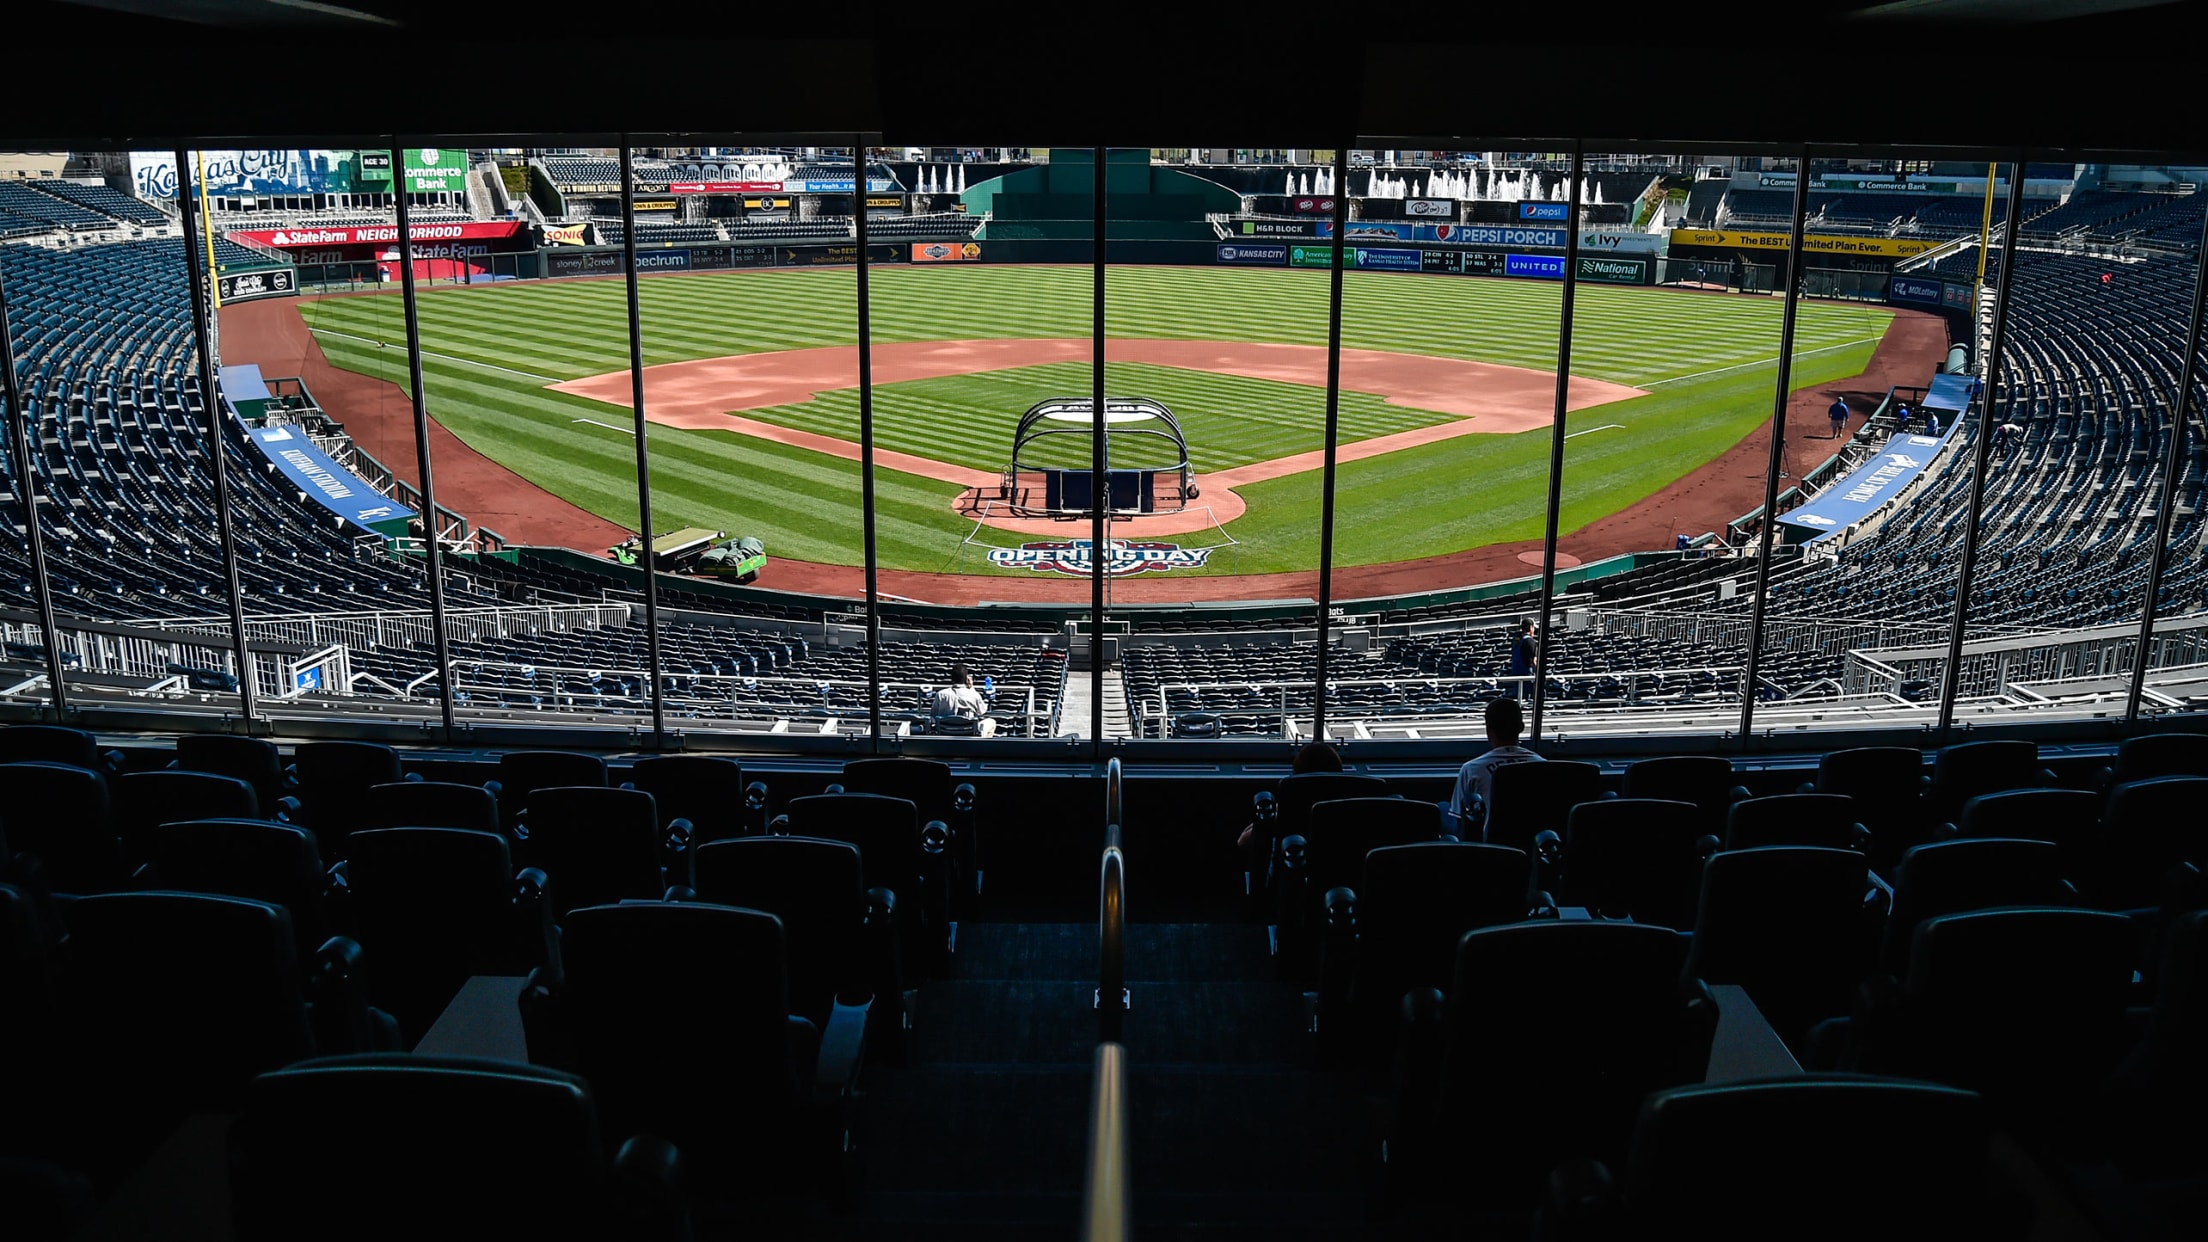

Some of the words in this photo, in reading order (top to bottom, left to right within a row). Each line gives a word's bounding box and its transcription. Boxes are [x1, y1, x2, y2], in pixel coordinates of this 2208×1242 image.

[138, 158, 237, 198] Kaas
[724, 167, 740, 180] Lite
[416, 178, 447, 189] Bank
[1770, 178, 1797, 186] Comme
[1808, 180, 1826, 188] Bank
[1866, 182, 1906, 190] Commerce
[1908, 182, 1926, 190] Bank
[1538, 208, 1560, 216] pepsi
[356, 226, 462, 240] NEIGHORHOOD
[1256, 224, 1274, 232] H&R
[546, 230, 583, 240] SONIC
[1462, 228, 1500, 242] PEPSI
[1504, 230, 1556, 245] PORCH
[1599, 234, 1621, 248] Ivy
[1694, 234, 1716, 243] Sprint
[1740, 236, 1757, 245] The
[1760, 238, 1783, 246] BEST
[1835, 241, 1856, 250] Plan
[1858, 242, 1882, 252] Ever.
[1898, 245, 1920, 254] Sprint
[1239, 250, 1268, 258] KANSAS
[557, 260, 582, 270] stoney
[594, 256, 616, 266] creek
[636, 255, 684, 268] pectrum
[1511, 262, 1557, 271] UNITED
[1594, 262, 1638, 274] National
[1144, 550, 1210, 562] DAY
